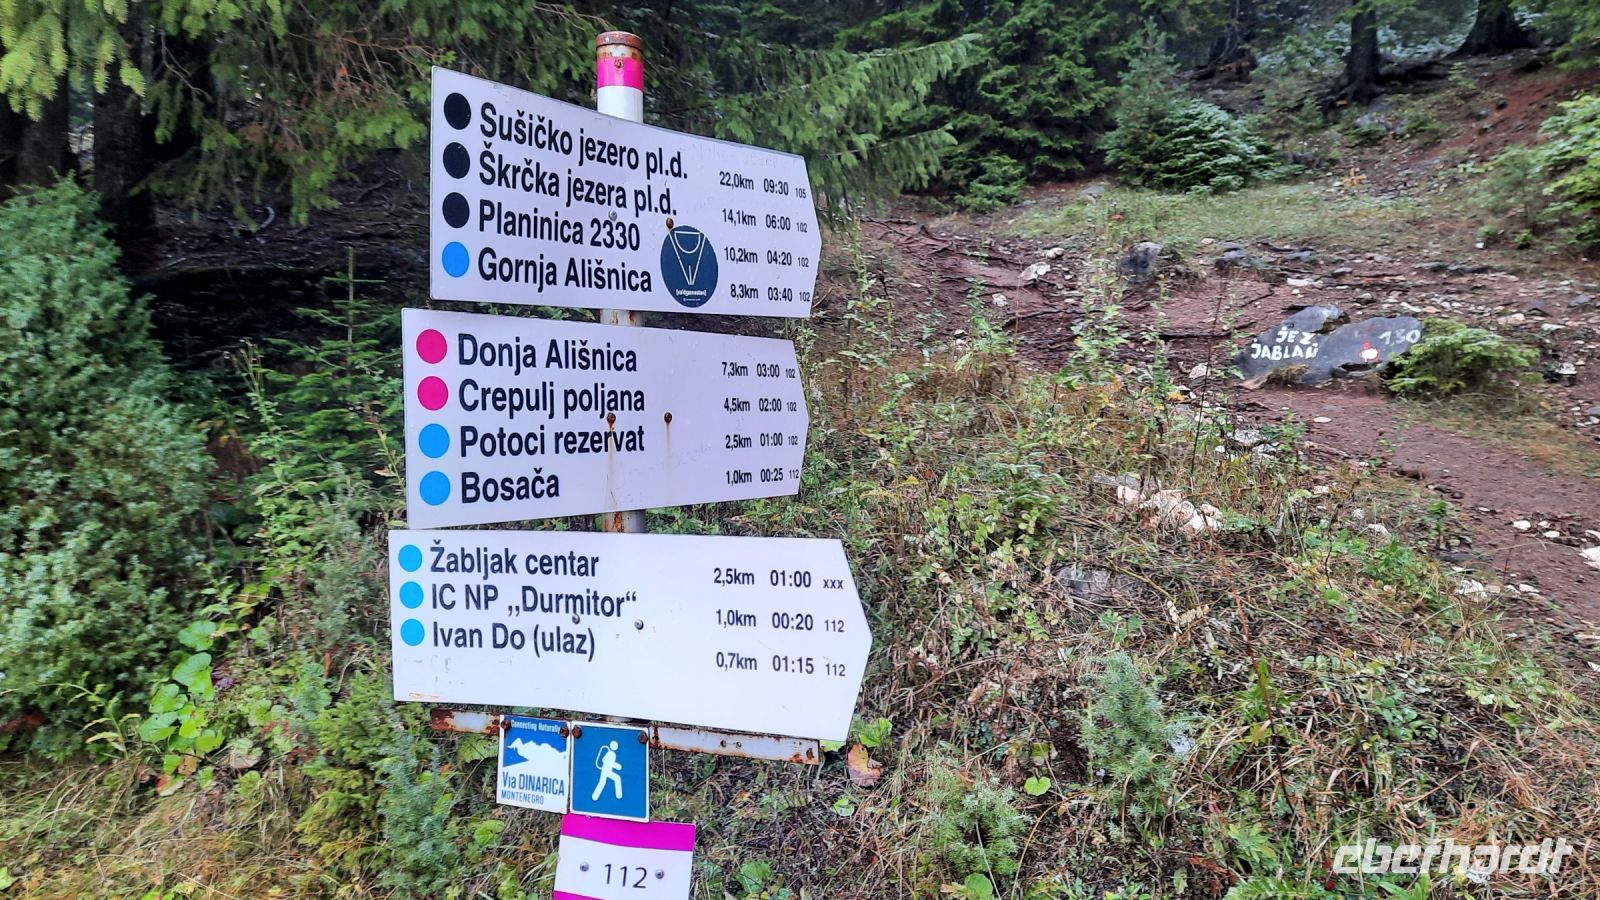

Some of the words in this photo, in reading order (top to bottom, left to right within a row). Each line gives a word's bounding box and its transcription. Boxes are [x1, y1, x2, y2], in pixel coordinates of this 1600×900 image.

[480, 102, 573, 155] Sušičko
[578, 128, 639, 170] jezero
[646, 148, 688, 179] pl.d.
[719, 171, 754, 190] 22,0km
[763, 178, 789, 196] 09:30
[795, 187, 807, 199] 105
[479, 141, 560, 197] Škrčka
[566, 169, 627, 209] jezera
[634, 185, 677, 217] pl.d.
[722, 208, 756, 227] 14,1km
[765, 214, 791, 231] 06:00
[796, 222, 808, 233] 102
[479, 199, 583, 245] Planinica
[590, 218, 640, 251] 2330
[724, 246, 758, 264] 10,2km
[766, 250, 792, 266] 04:20
[798, 257, 809, 268] 102
[478, 247, 557, 293] Gornja
[564, 257, 652, 292] Ališnica
[730, 283, 759, 301] 8,3km
[767, 287, 793, 302] 03:40
[799, 291, 810, 302] 102
[458, 333, 536, 376] Donja
[545, 338, 637, 372] Ališnica
[722, 361, 748, 379] 7,3km
[756, 363, 780, 378] 03:00
[785, 368, 796, 379] 102
[458, 378, 555, 420] Crepulj
[564, 382, 645, 420] poljana
[723, 397, 751, 414] 4,5km
[758, 398, 782, 412] 02:00
[786, 402, 797, 412] 102
[460, 425, 545, 458] Potoci
[554, 425, 645, 454] rezervat
[725, 434, 752, 451] 2,5km
[760, 432, 783, 447] 01:00
[788, 435, 798, 446] 102
[461, 467, 560, 504] Bosača
[726, 469, 752, 486] 1,0km
[760, 468, 784, 482] 00:25
[789, 469, 799, 479] 112
[430, 539, 518, 580] Žabljak
[525, 550, 599, 577] centar
[713, 567, 755, 587] 2,5km
[770, 569, 812, 588] 01:00
[823, 578, 844, 590] xxx
[432, 583, 456, 611] IC
[465, 584, 498, 611] NP
[715, 609, 757, 628] 1,0km
[771, 612, 814, 631] 00:20
[824, 619, 845, 633] 112
[433, 621, 483, 649] Ivan
[492, 622, 525, 650] Do
[533, 624, 595, 662] (ulaz)
[716, 651, 758, 671] 0,7km
[772, 655, 814, 674] 01:15
[825, 663, 846, 677] 112
[511, 719, 537, 732] Connecting
[539, 722, 561, 735] Naturally
[501, 789, 544, 805] MONTENEGRO
[502, 771, 517, 789] Via
[518, 773, 565, 797] DINARICA
[604, 863, 648, 889] 112
